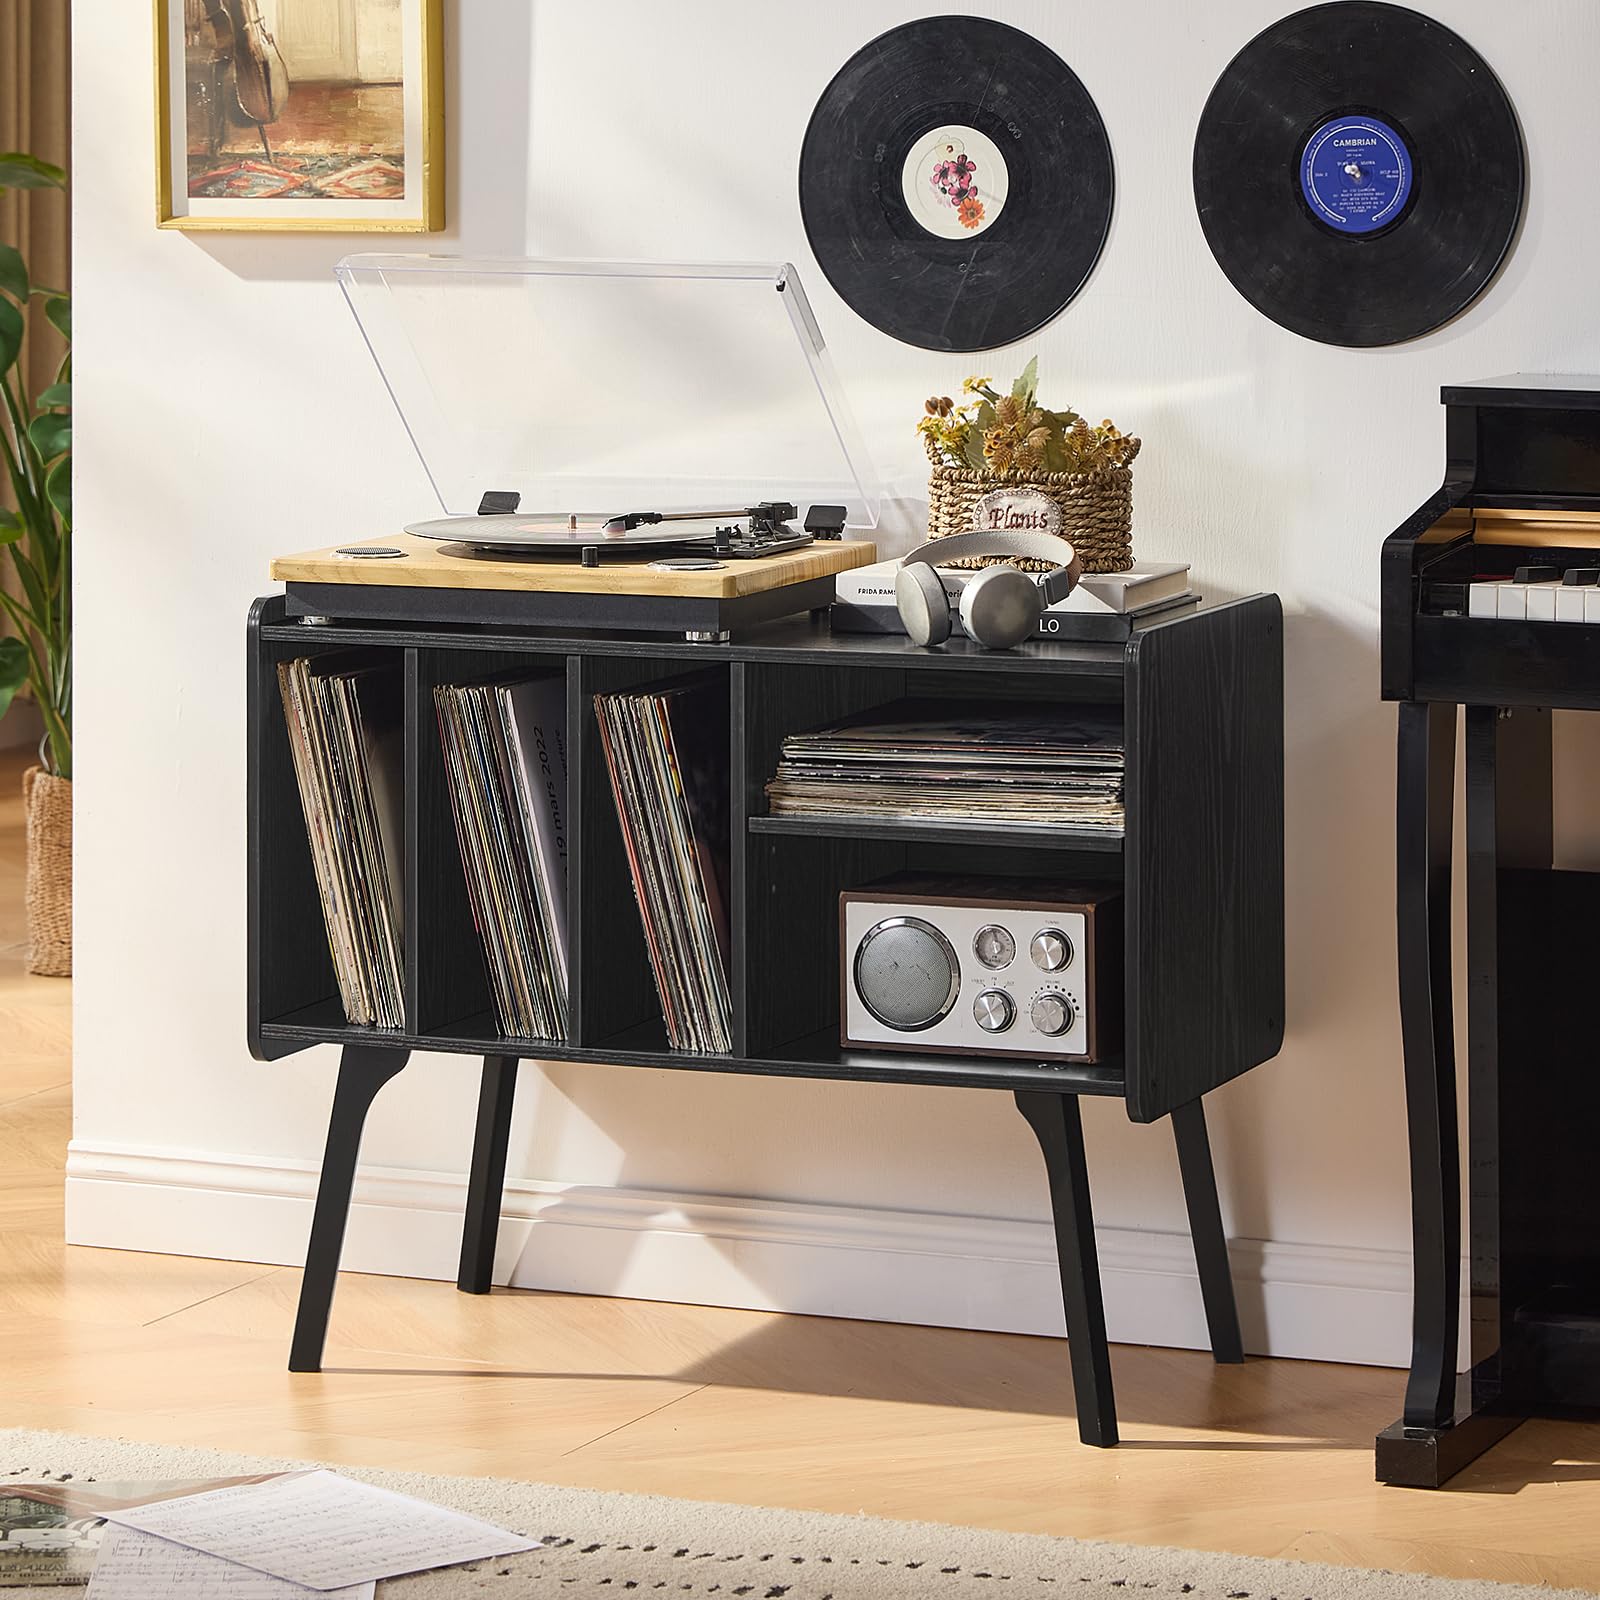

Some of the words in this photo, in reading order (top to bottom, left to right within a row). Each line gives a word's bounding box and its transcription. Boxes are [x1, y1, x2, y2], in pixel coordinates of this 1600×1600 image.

[1333, 138, 1377, 147] CAMBRIAN
[988, 504, 1049, 530] Plants
[533, 726, 552, 775] 2022
[546, 781, 562, 831] mars
